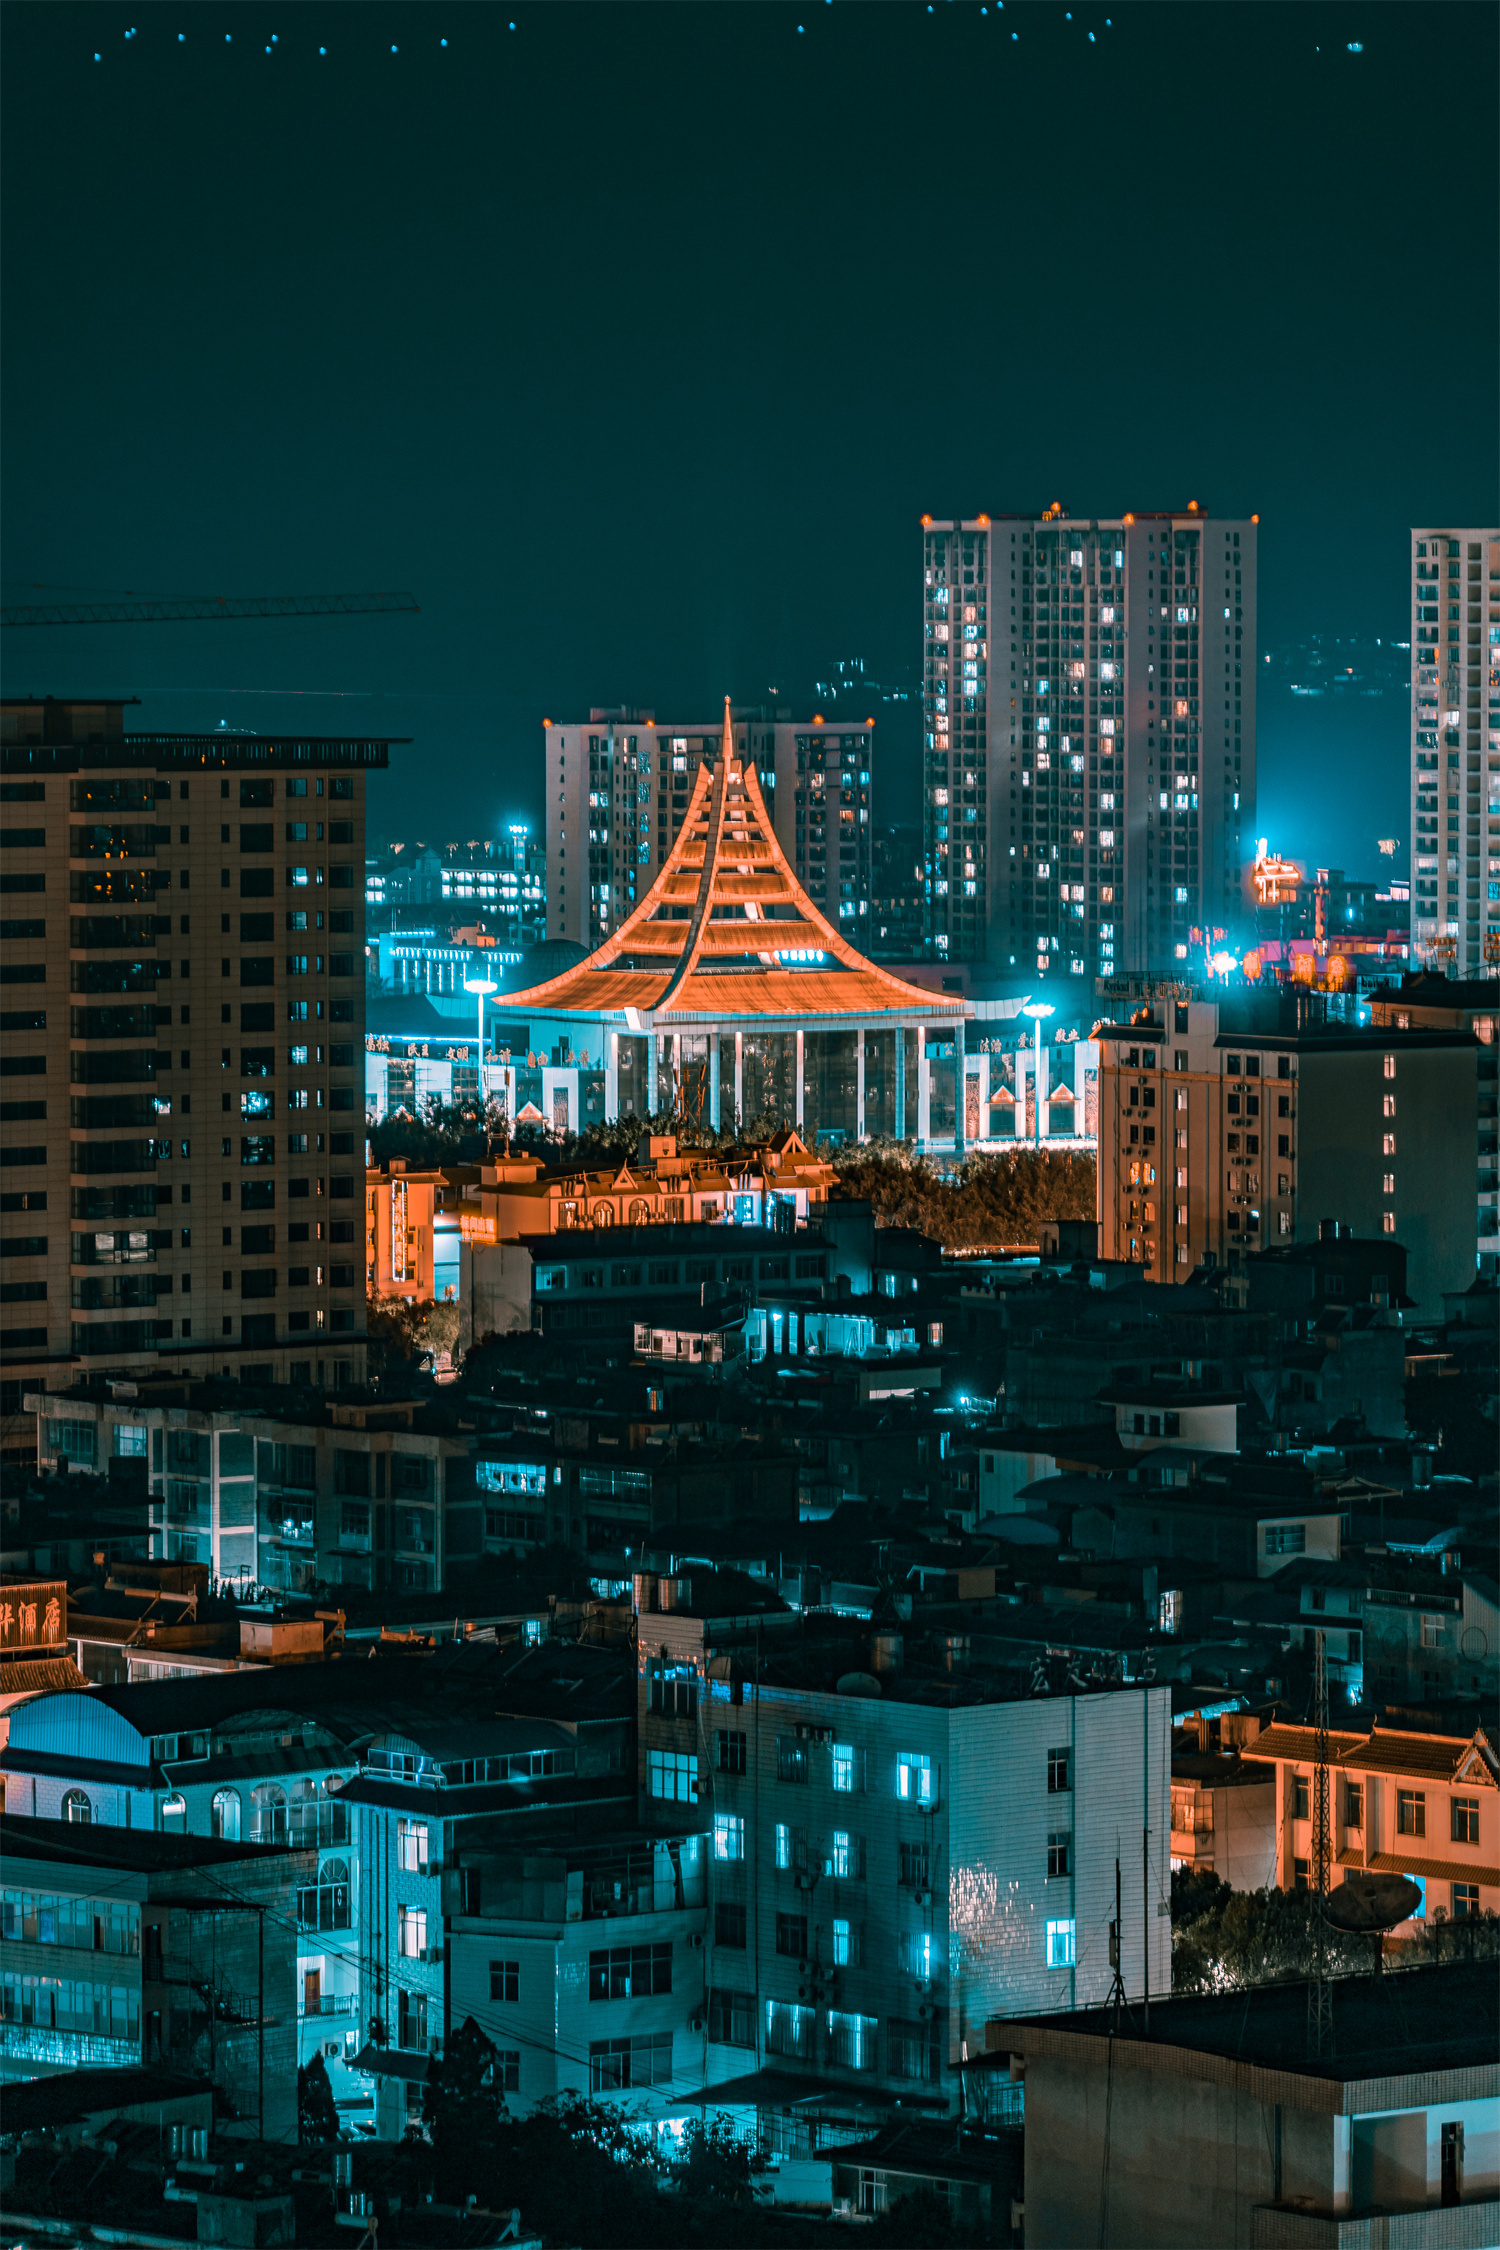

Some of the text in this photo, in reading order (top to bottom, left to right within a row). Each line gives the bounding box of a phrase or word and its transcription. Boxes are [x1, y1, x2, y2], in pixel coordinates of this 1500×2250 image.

[980, 1038, 1001, 1053] 法治
[1055, 1028, 1080, 1043] 敬业
[407, 1043, 429, 1057] 民主
[446, 1046, 469, 1062] 文明
[485, 1048, 511, 1065] 和谐
[527, 1051, 548, 1068] 自由
